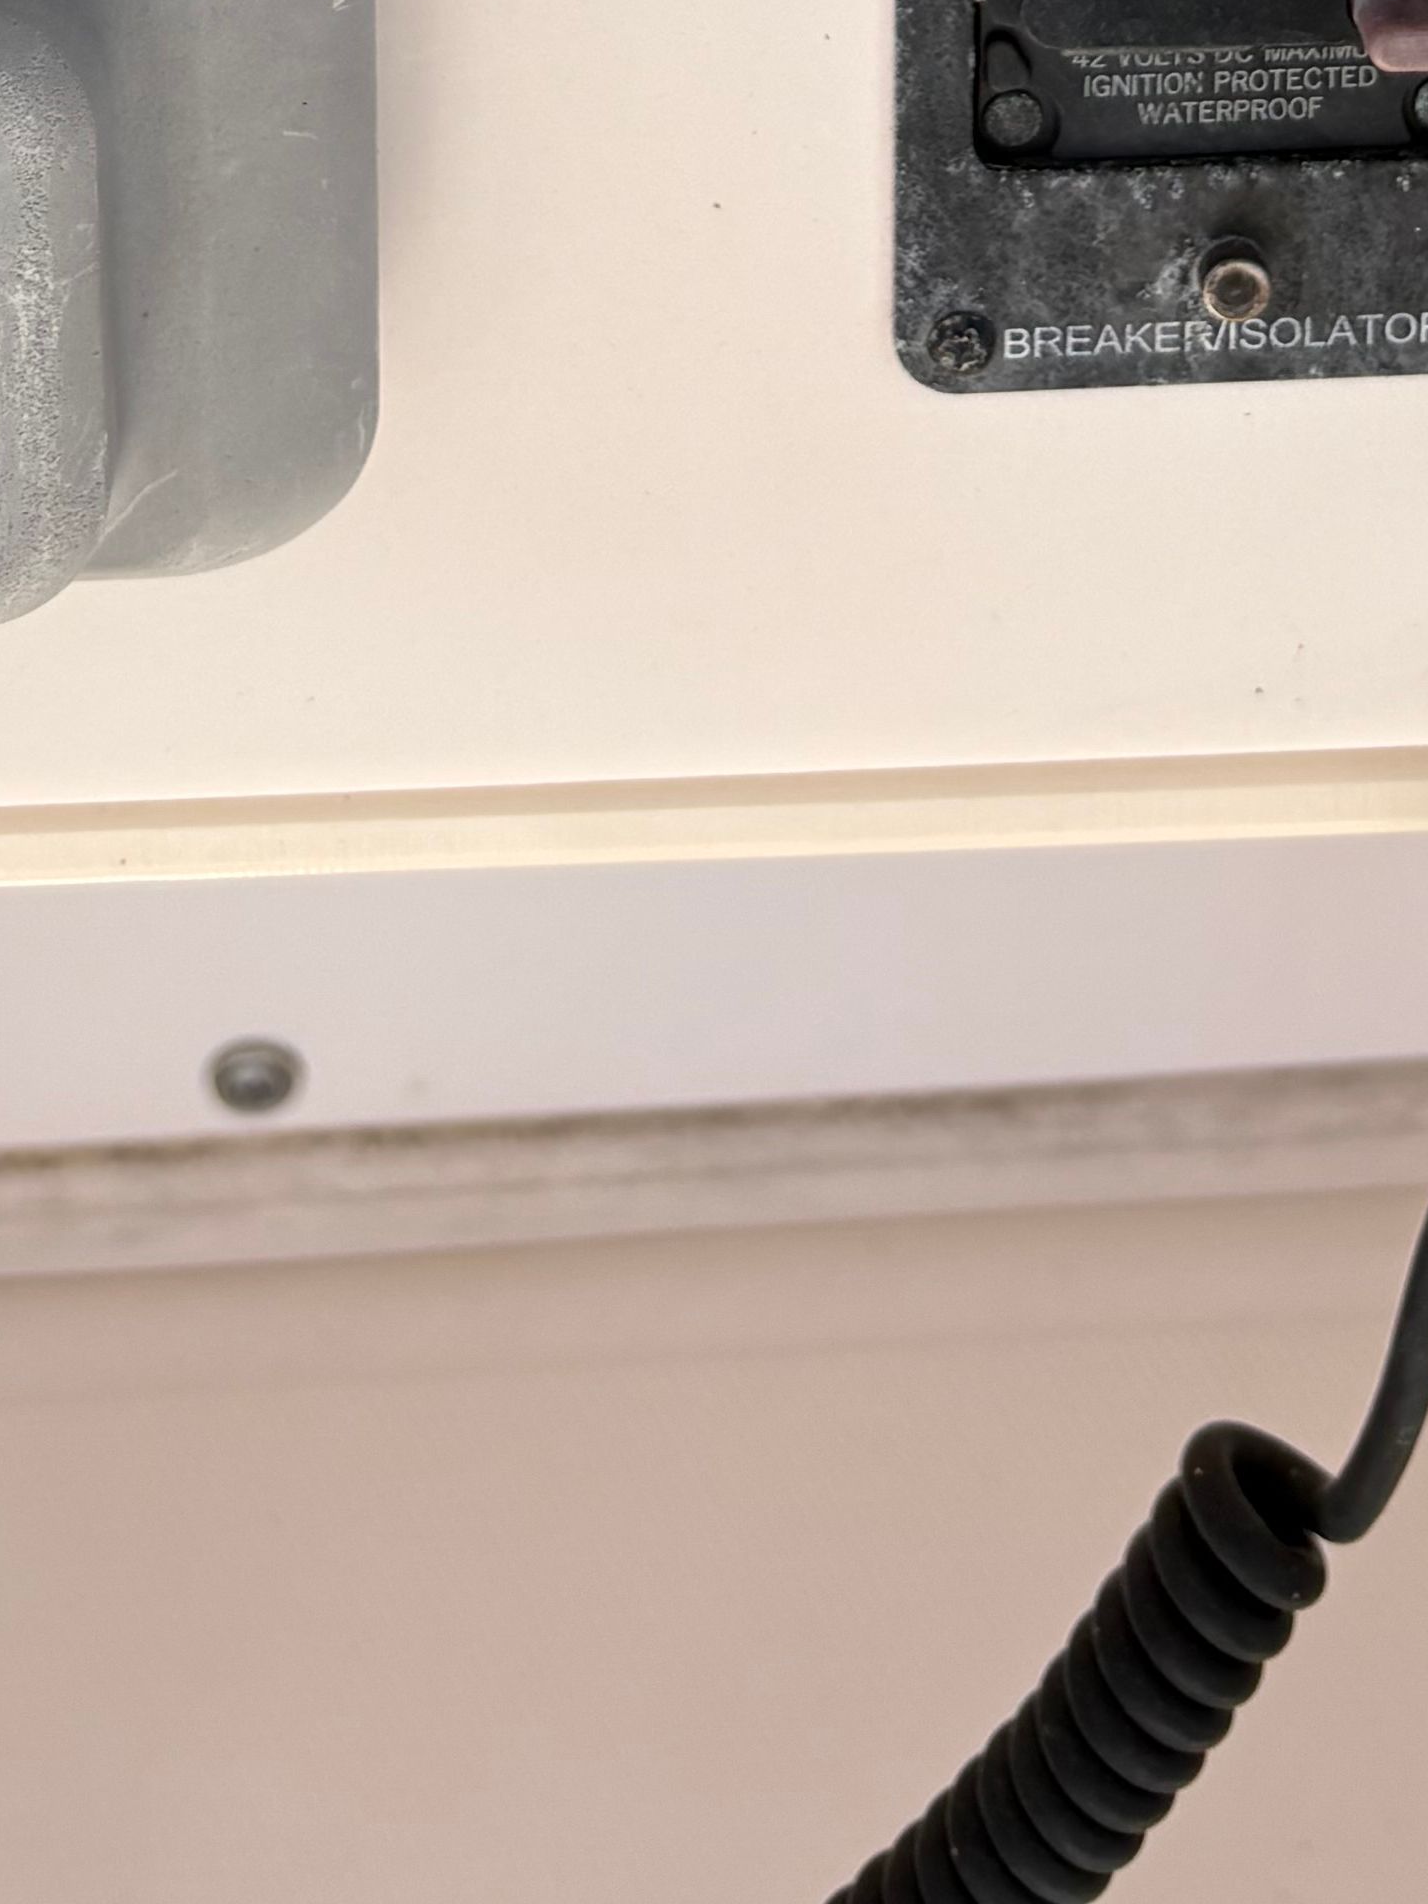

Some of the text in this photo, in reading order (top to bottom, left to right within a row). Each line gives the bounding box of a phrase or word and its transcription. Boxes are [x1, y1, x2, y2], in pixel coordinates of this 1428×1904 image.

[1083, 65, 1378, 98] IGNITION PROTECTED
[1137, 96, 1324, 126] WATERPROOF
